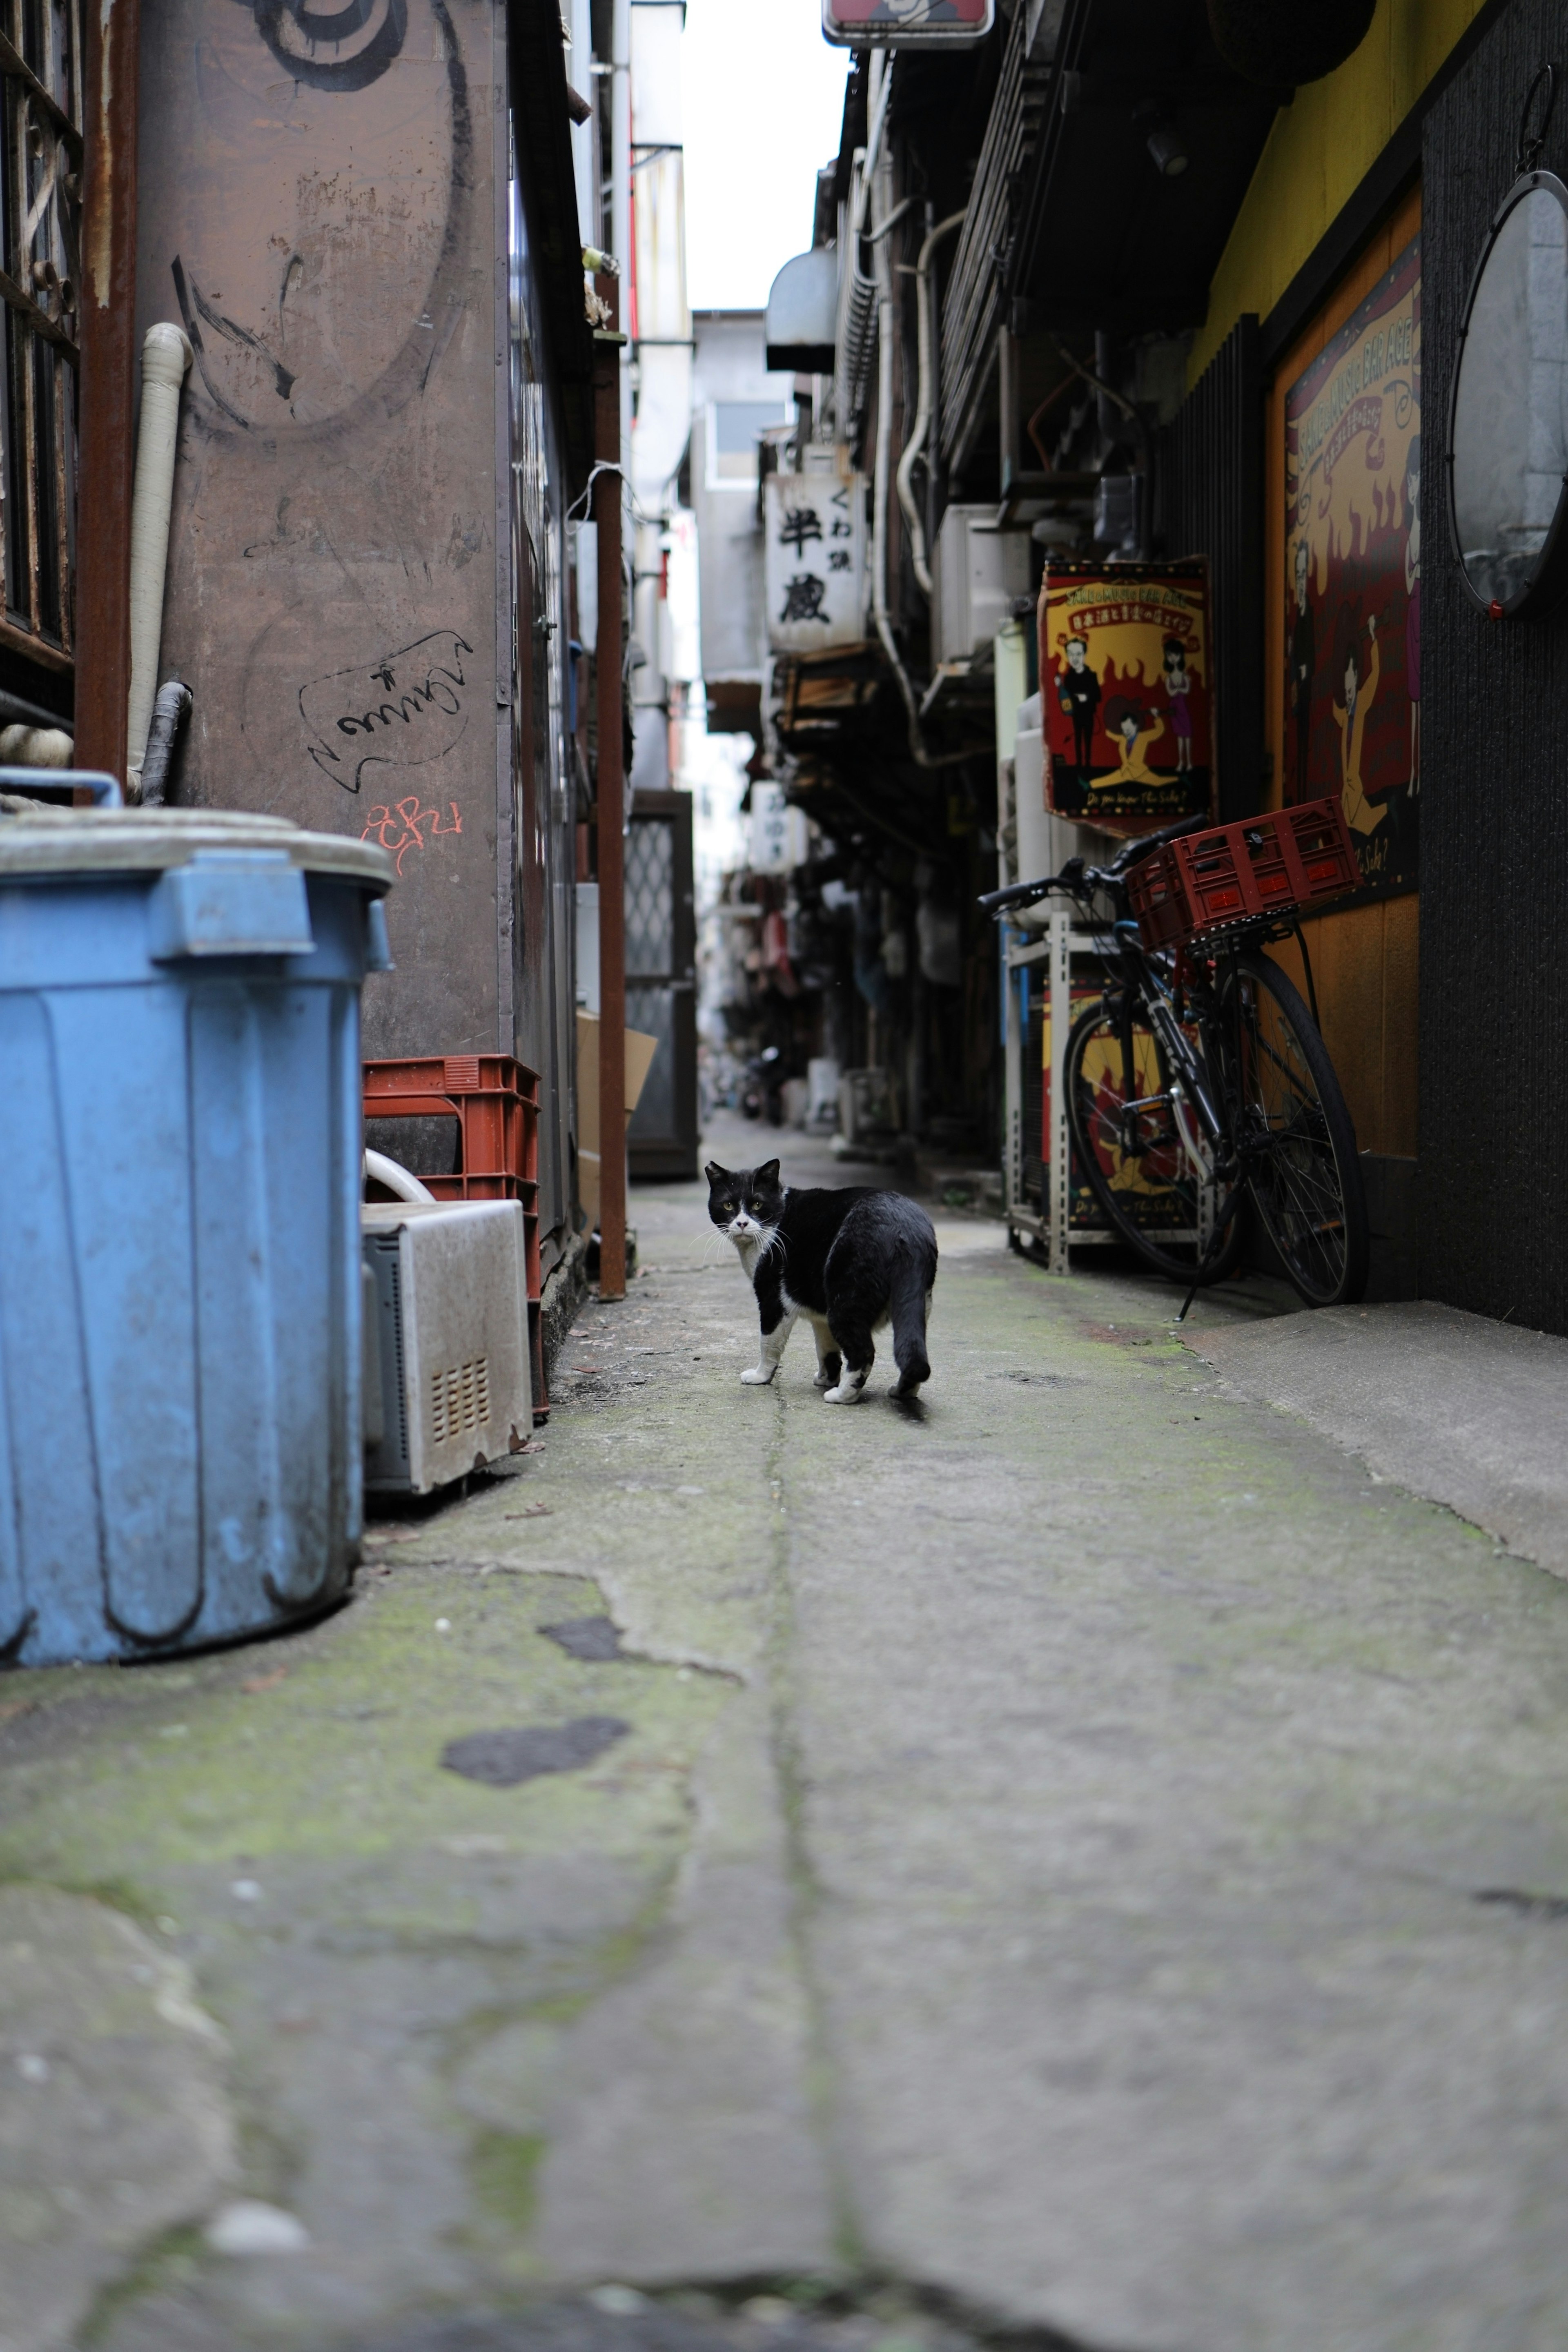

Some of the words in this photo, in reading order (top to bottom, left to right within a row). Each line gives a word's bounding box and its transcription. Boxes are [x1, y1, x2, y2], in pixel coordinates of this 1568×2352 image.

[1299, 400, 1325, 471] SAKE
[1330, 355, 1361, 421] MUSIC
[1363, 330, 1385, 390] BAR
[1385, 316, 1412, 374] AGE
[780, 508, 831, 624] 半蔵
[1066, 588, 1094, 606] SAKE
[1102, 587, 1136, 602] MUSIC
[1139, 587, 1160, 604] BAR
[1162, 589, 1187, 608] AGE
[1087, 791, 1099, 807] Do
